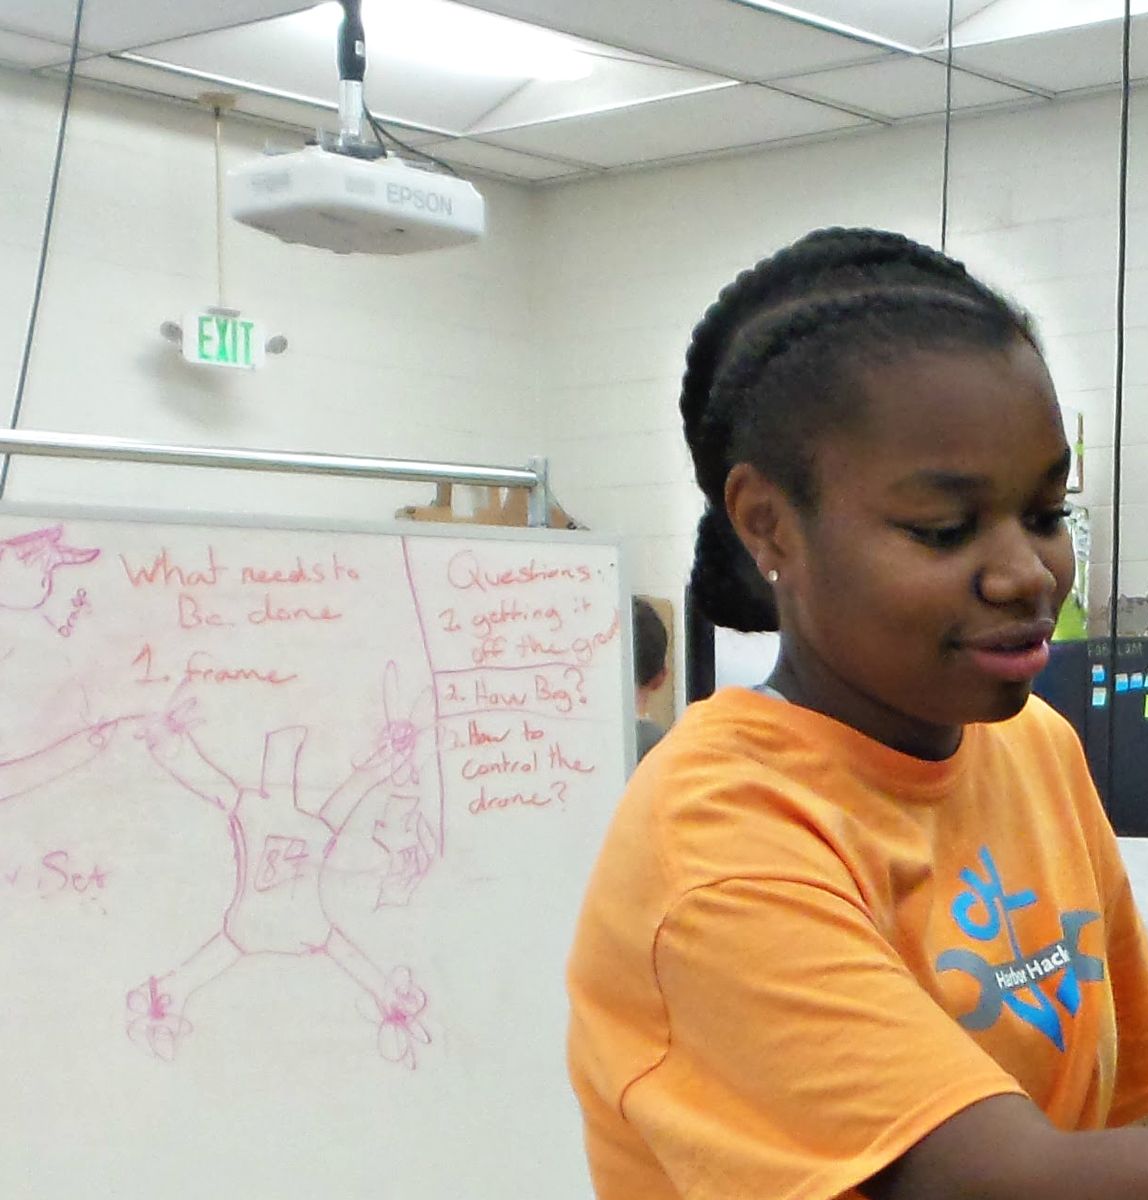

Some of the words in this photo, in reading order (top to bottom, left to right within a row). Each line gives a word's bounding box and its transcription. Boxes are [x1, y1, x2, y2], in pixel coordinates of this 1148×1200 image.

[386, 182, 453, 216] EPSON
[198, 315, 254, 366] EXIT
[119, 544, 229, 588] What
[248, 592, 343, 625] done
[472, 599, 563, 639] getting
[184, 650, 298, 685] frame
[475, 675, 527, 707] How
[468, 719, 511, 746] How
[523, 719, 545, 742] to
[549, 741, 596, 774] the
[1026, 944, 1072, 980] Hack
